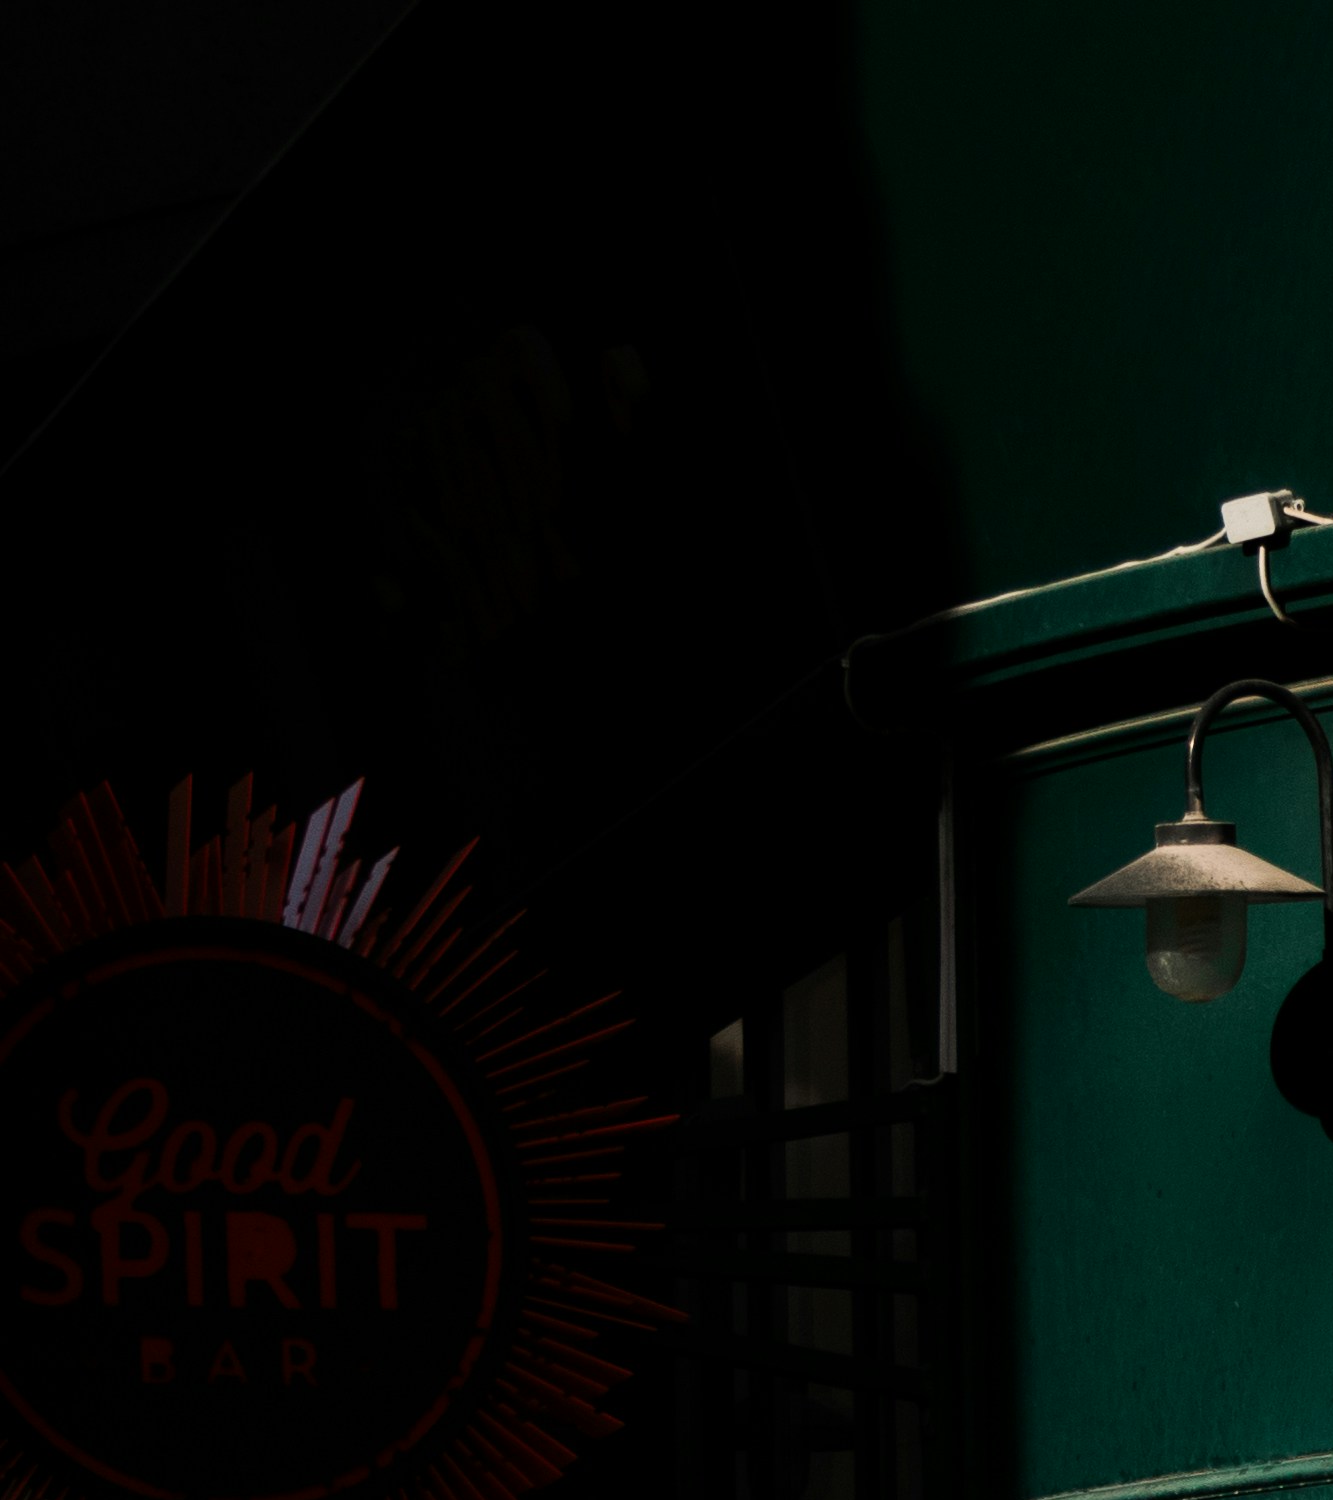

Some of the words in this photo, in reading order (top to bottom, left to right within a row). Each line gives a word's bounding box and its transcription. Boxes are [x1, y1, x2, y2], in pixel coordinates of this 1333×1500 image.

[56, 1076, 368, 1208] Good
[16, 1206, 430, 1312] SPIRIT
[139, 1334, 322, 1389] BAR
